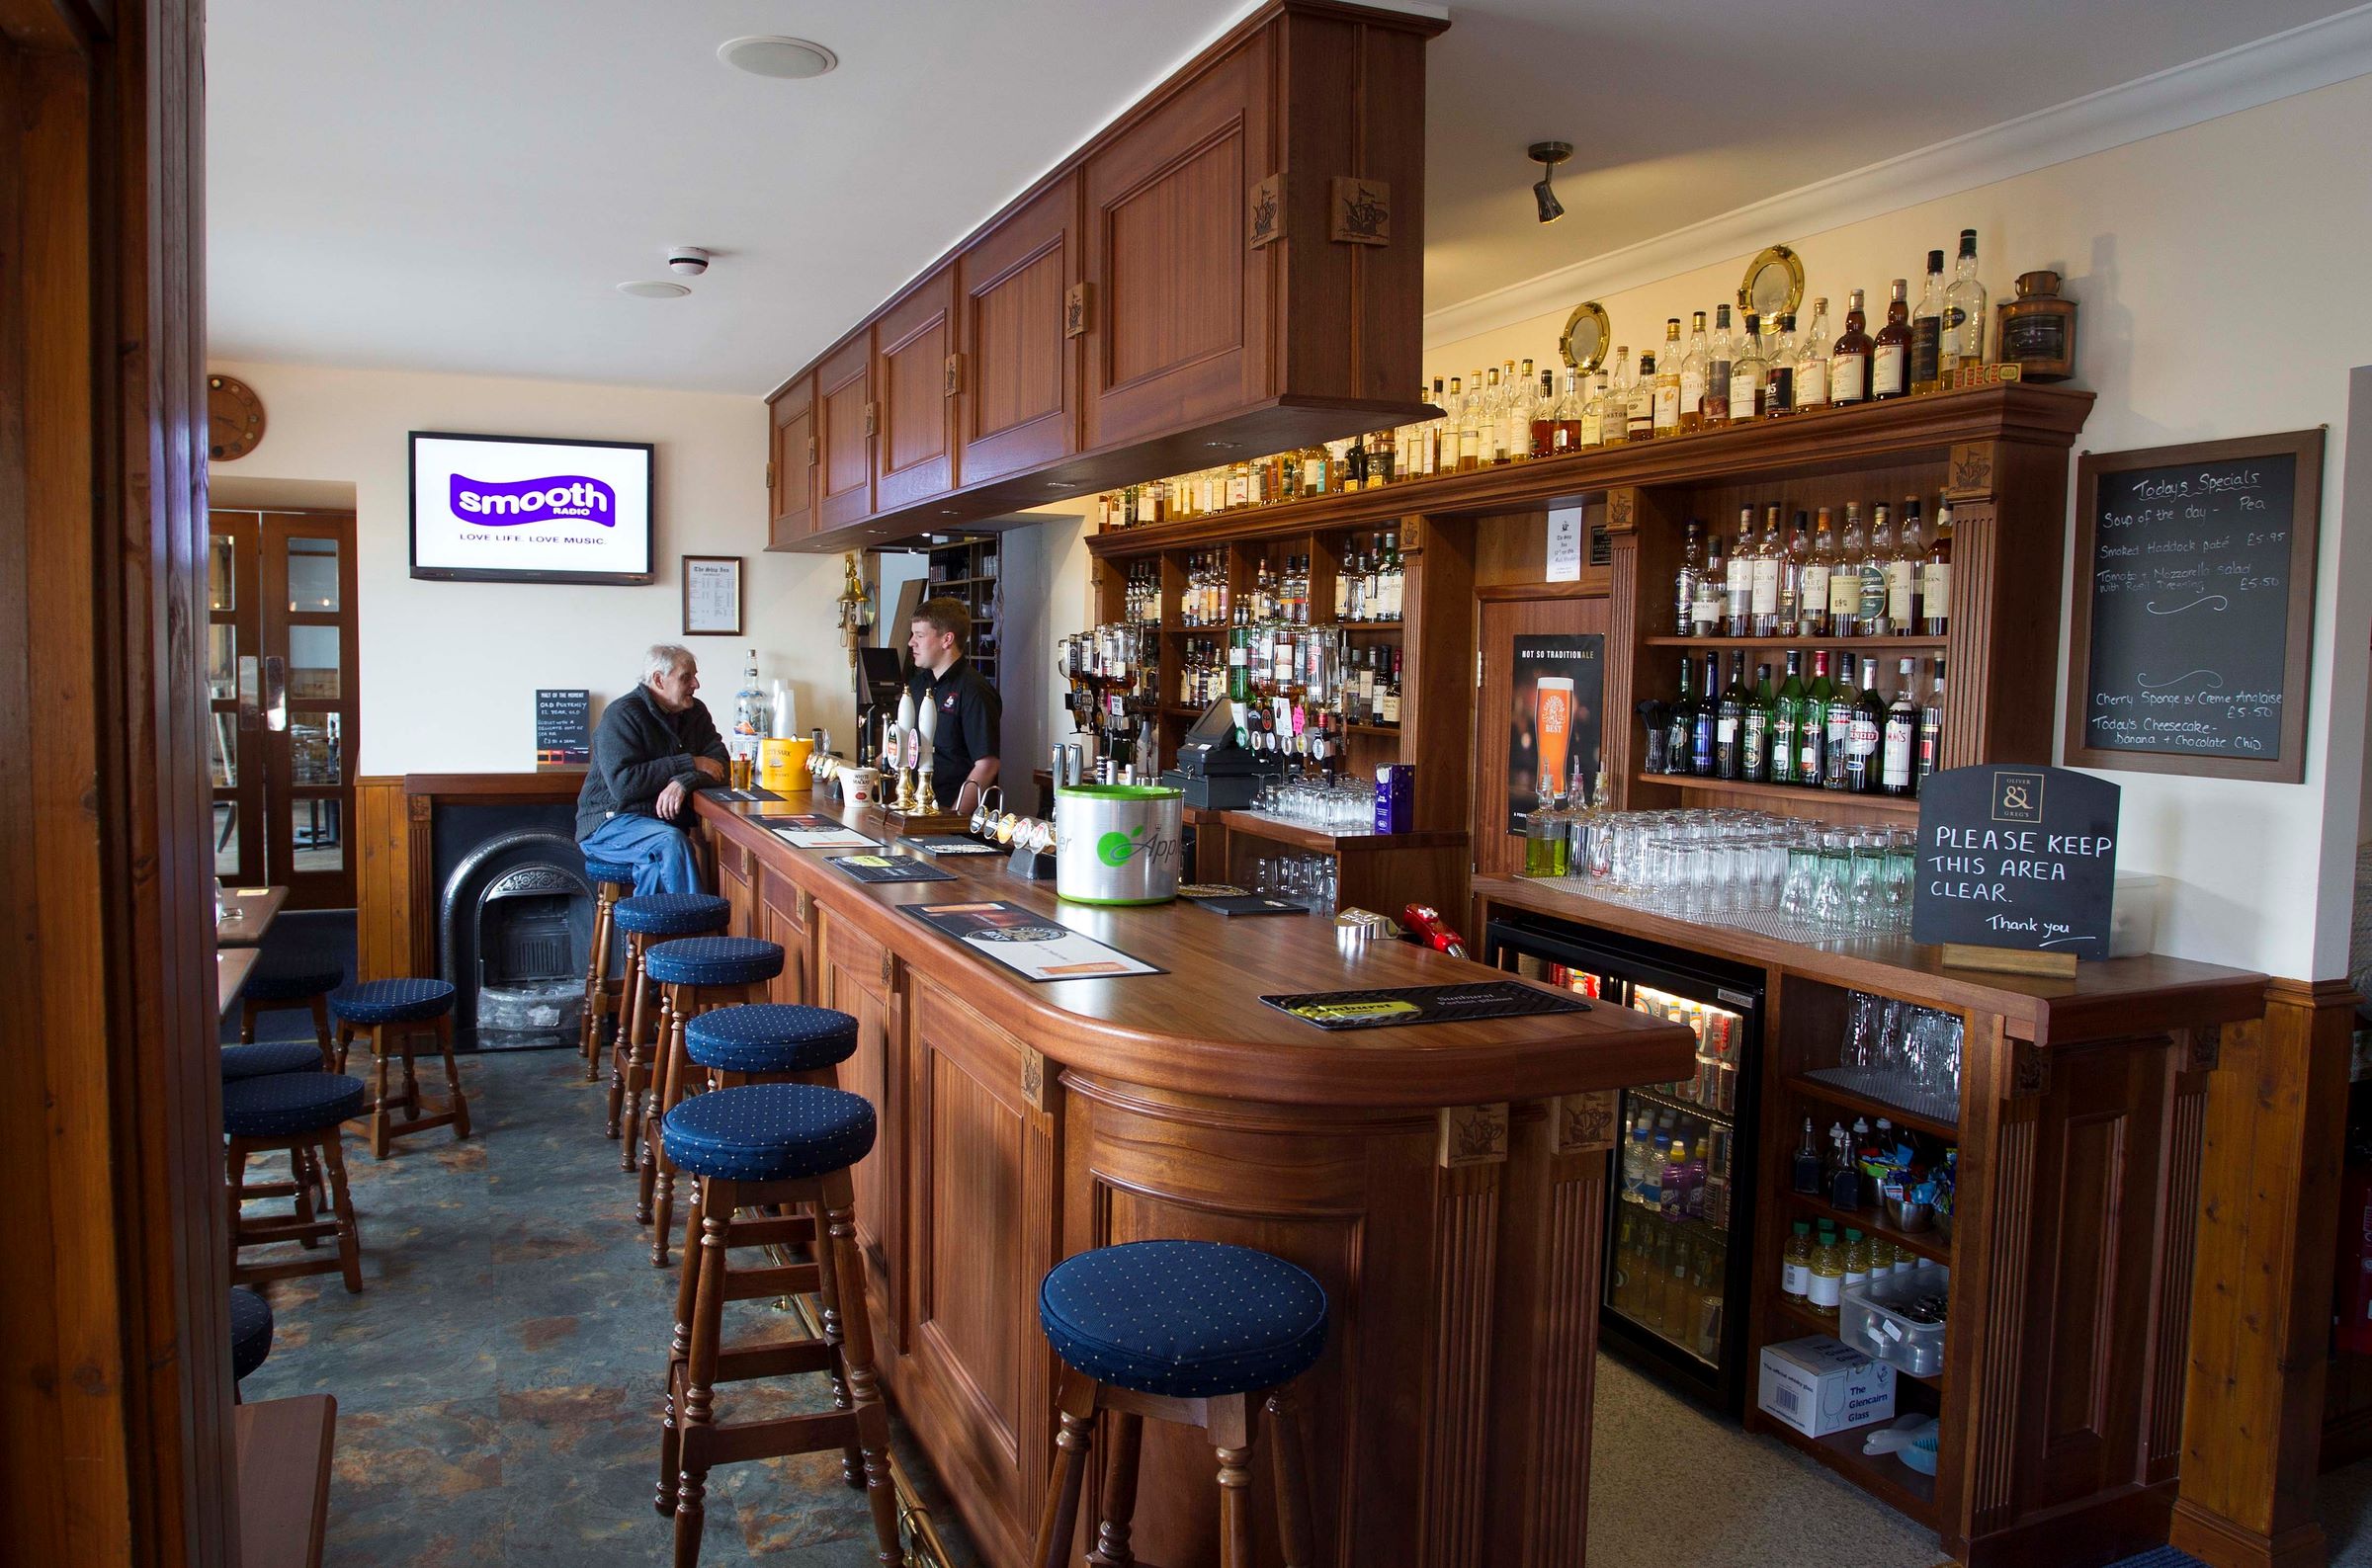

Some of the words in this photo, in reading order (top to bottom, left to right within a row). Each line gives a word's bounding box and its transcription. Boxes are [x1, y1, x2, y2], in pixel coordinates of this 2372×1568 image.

[2198, 470, 2260, 493] Specials
[459, 482, 608, 515] smooth
[552, 507, 590, 516] RADIO
[2102, 513, 2133, 529] Soup
[2137, 509, 2152, 527] of
[2157, 508, 2174, 522] the
[2185, 504, 2206, 528] day
[2240, 496, 2266, 511] Pea
[2099, 544, 2140, 559] Smoked
[2148, 539, 2196, 554] Haddock
[2096, 569, 2137, 583] Tomato
[2096, 693, 2133, 710] Cherry
[2142, 691, 2180, 711] Sponge
[2236, 690, 2283, 708] Anglaise
[2174, 734, 2227, 749] Chocolate
[1935, 825, 2038, 854] PLEASE
[2048, 834, 2112, 858] KEEP
[1927, 856, 1986, 875] THIS
[1999, 859, 2066, 880] AREA
[1986, 913, 2038, 932] Thank
[2043, 921, 2070, 939] you
[1850, 1386, 1866, 1395] The
[1848, 1393, 1888, 1409] Glencairn
[1848, 1411, 1870, 1422] Glass
